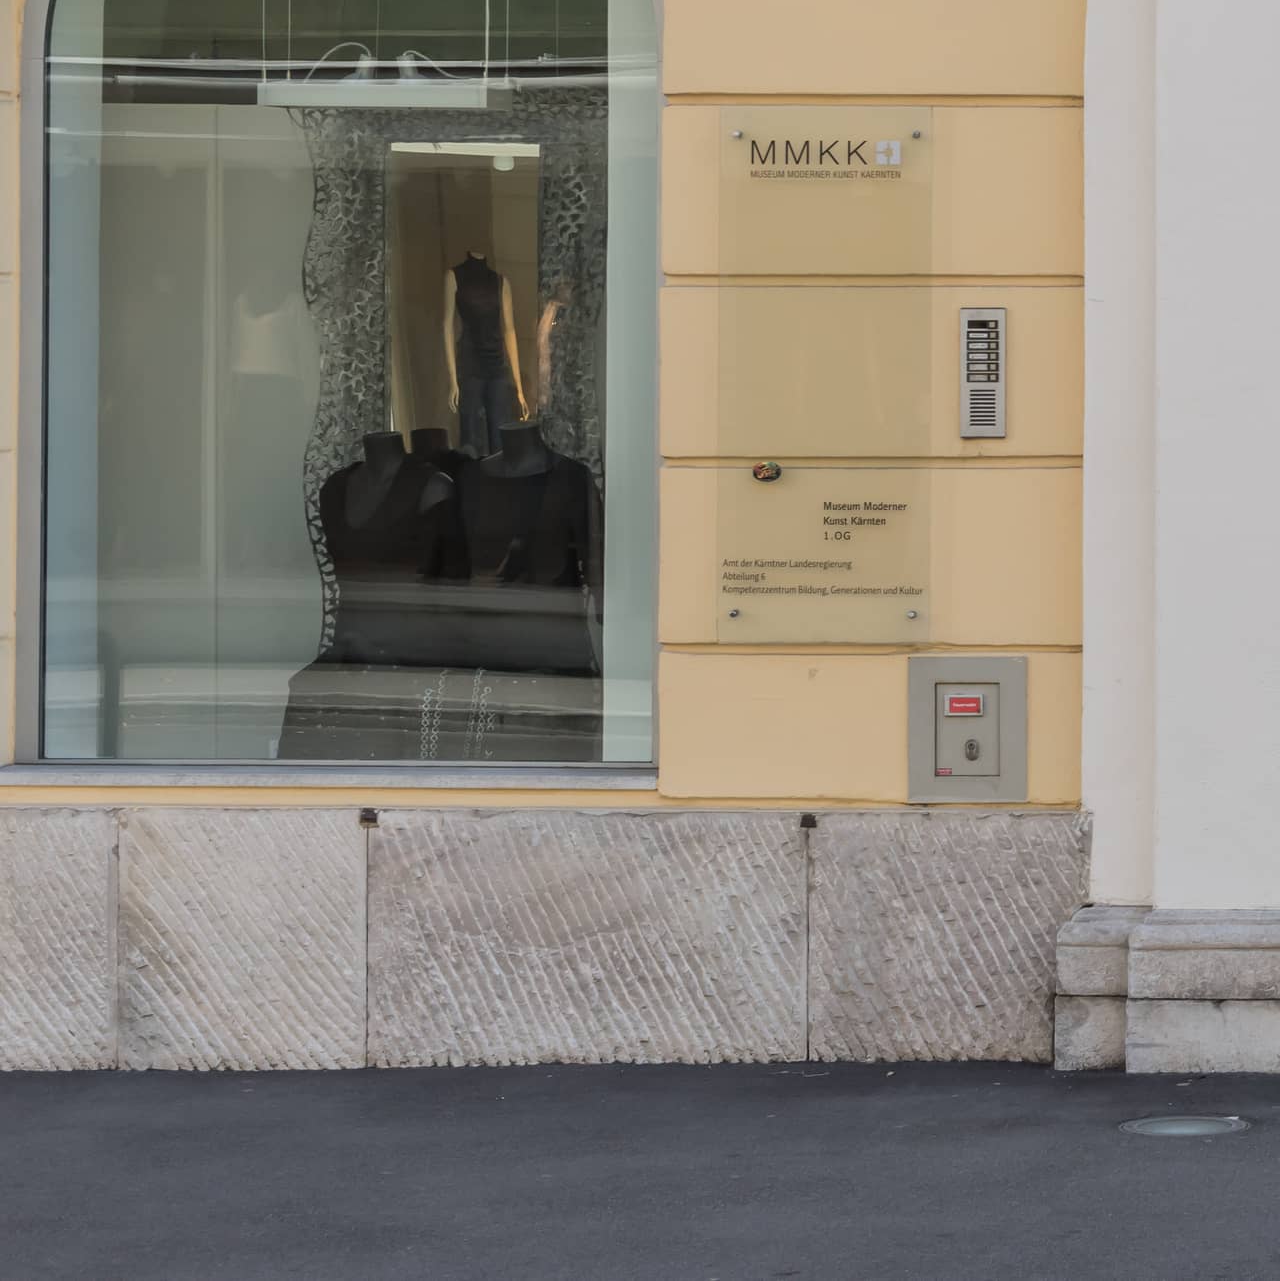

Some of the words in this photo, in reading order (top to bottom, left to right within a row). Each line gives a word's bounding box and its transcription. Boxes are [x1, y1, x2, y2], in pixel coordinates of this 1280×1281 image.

[751, 140, 868, 165] MMKK
[750, 170, 785, 179] MUSEUM
[787, 170, 831, 179] MODERNER
[833, 170, 858, 179] KUNST
[861, 170, 901, 179] KAERNTEN
[823, 501, 861, 511] Museum
[863, 501, 908, 511] Moderner
[823, 516, 848, 526] Kunst
[850, 516, 887, 526] Kärnten
[722, 559, 739, 568] Amt
[740, 559, 753, 568] der
[789, 559, 852, 571] Landesregierung
[722, 572, 760, 583] Abteilung
[722, 585, 797, 595] Kompetenzzentrum
[831, 585, 881, 595] Generationen
[882, 585, 898, 595] und
[899, 585, 923, 595] Kultur
